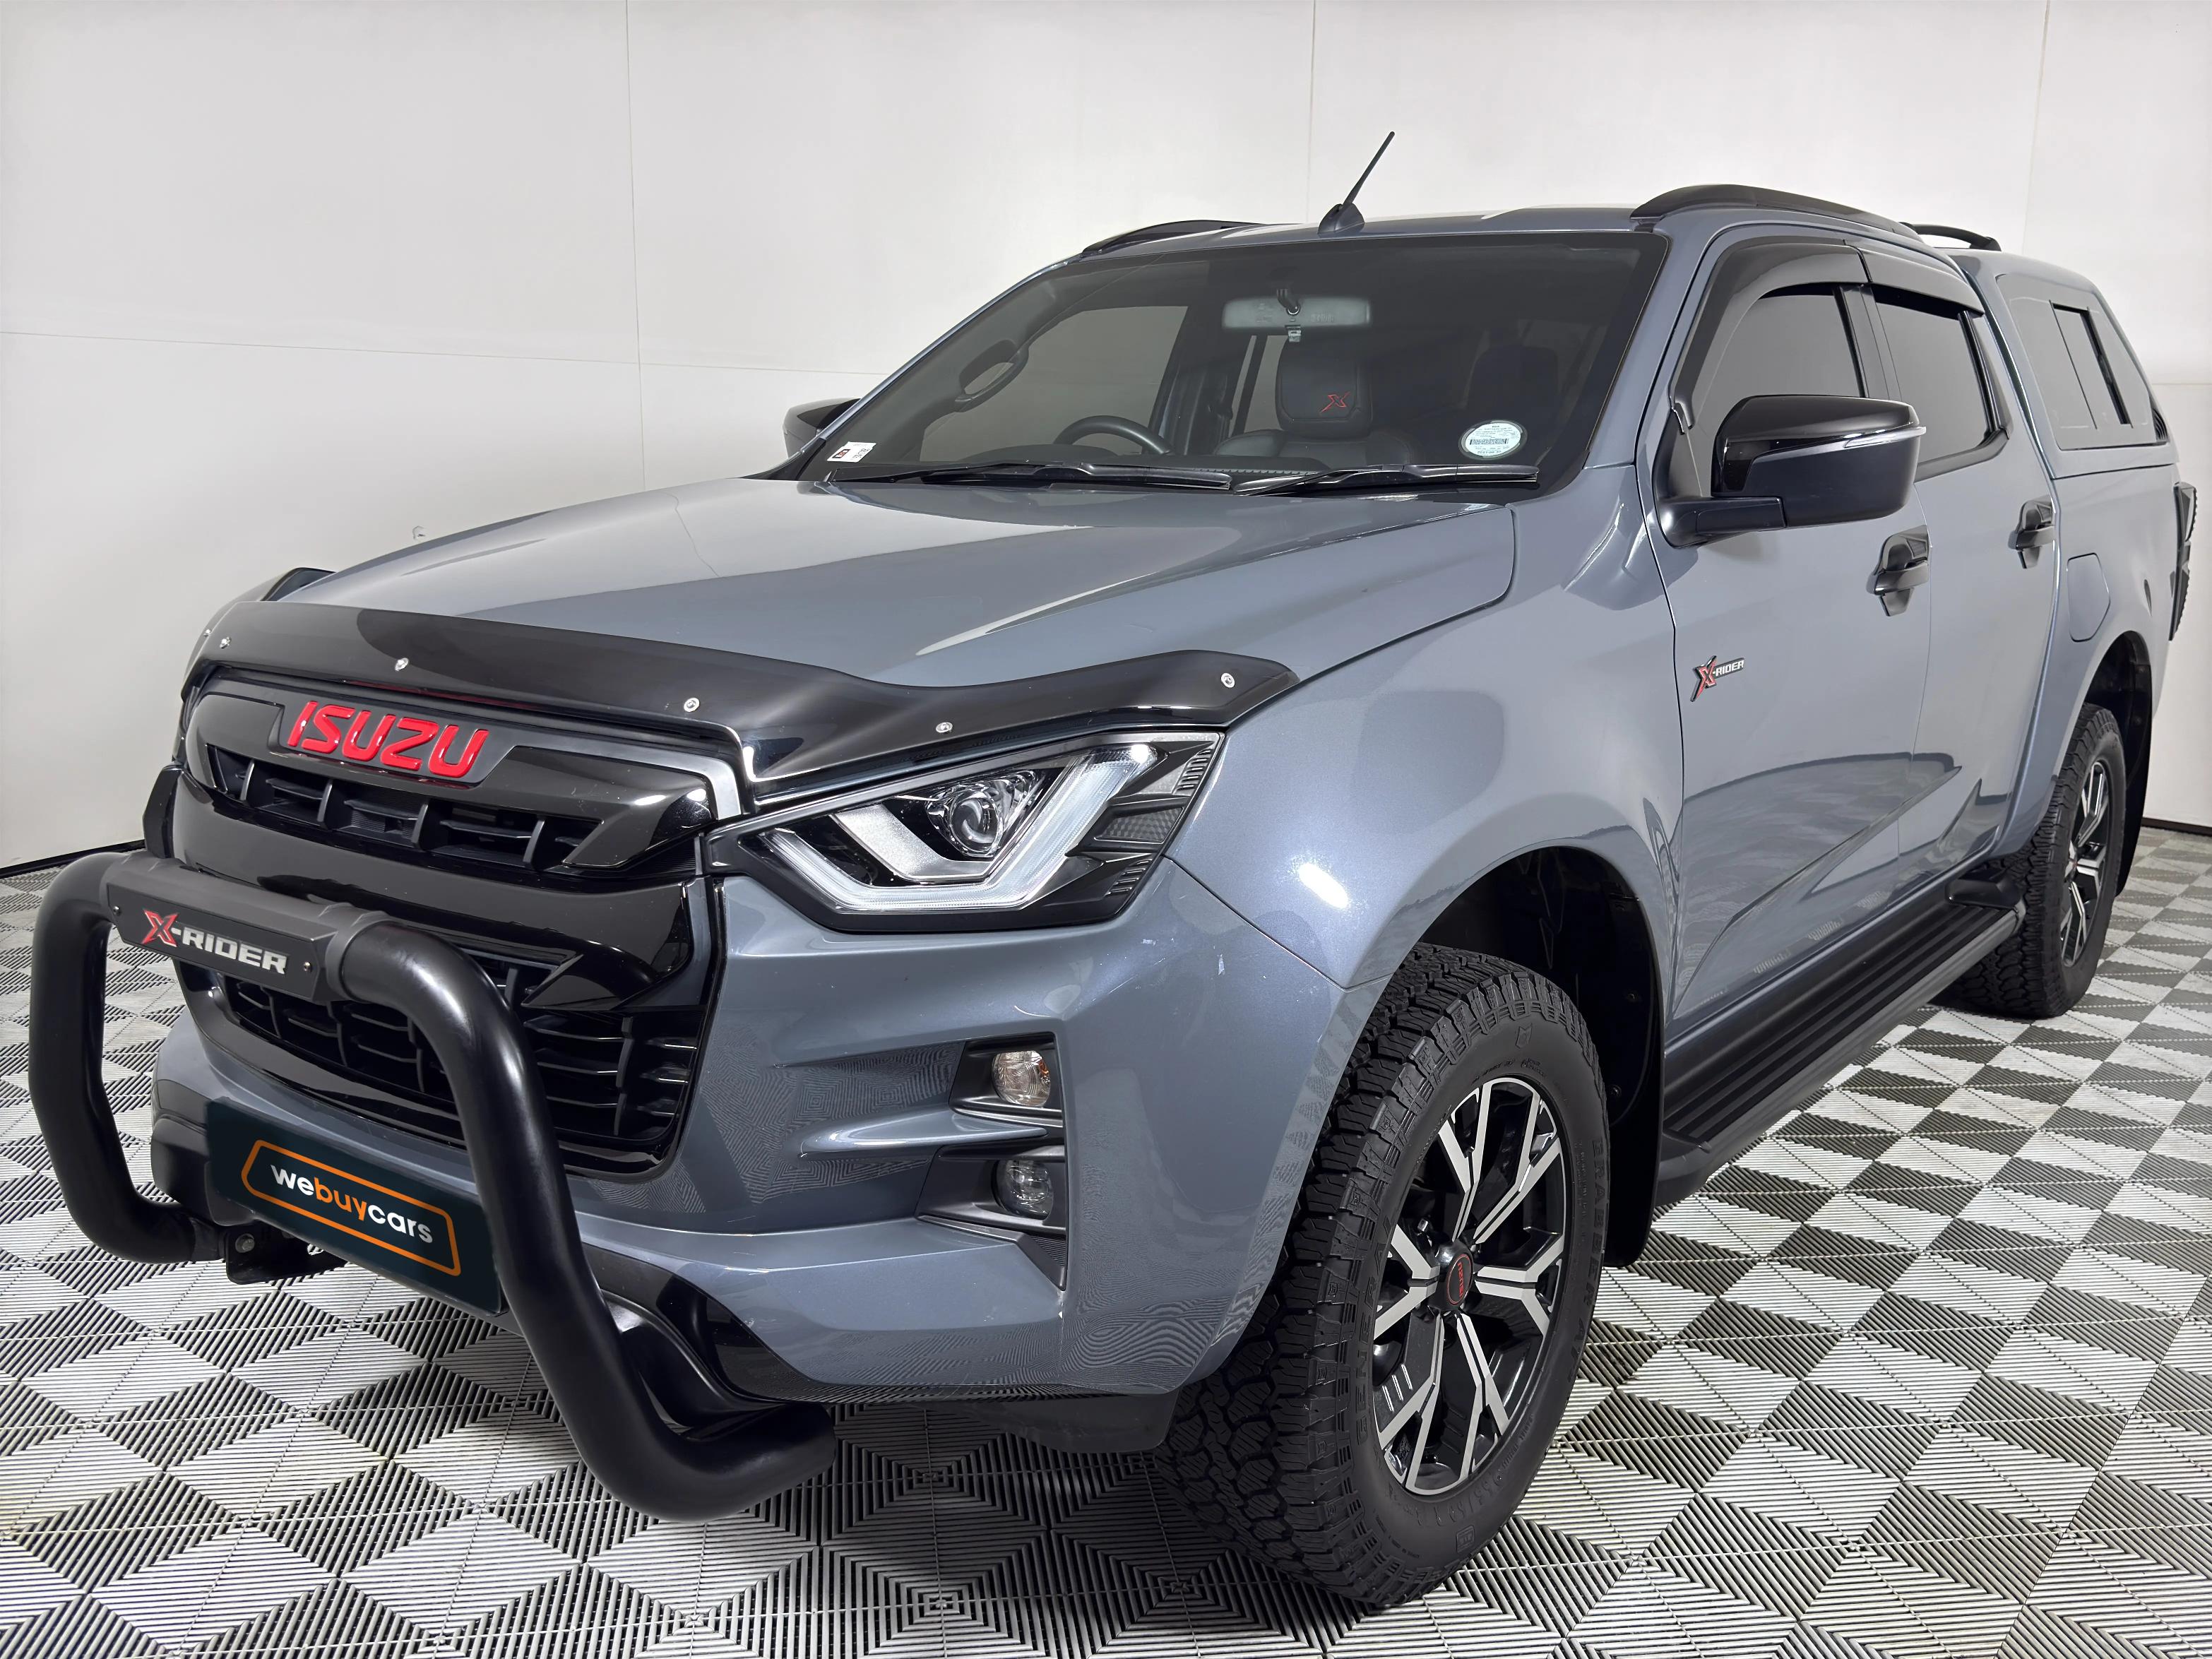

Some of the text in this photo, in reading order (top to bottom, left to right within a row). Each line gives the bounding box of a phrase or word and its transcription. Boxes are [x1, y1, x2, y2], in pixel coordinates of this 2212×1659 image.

[1690, 655, 1744, 702] X-RIDER
[287, 700, 489, 778] ISUZU
[141, 908, 287, 975] X-RIDER
[270, 1165, 434, 1243] webuycars
[1355, 1215, 1393, 1446] GENERAL
